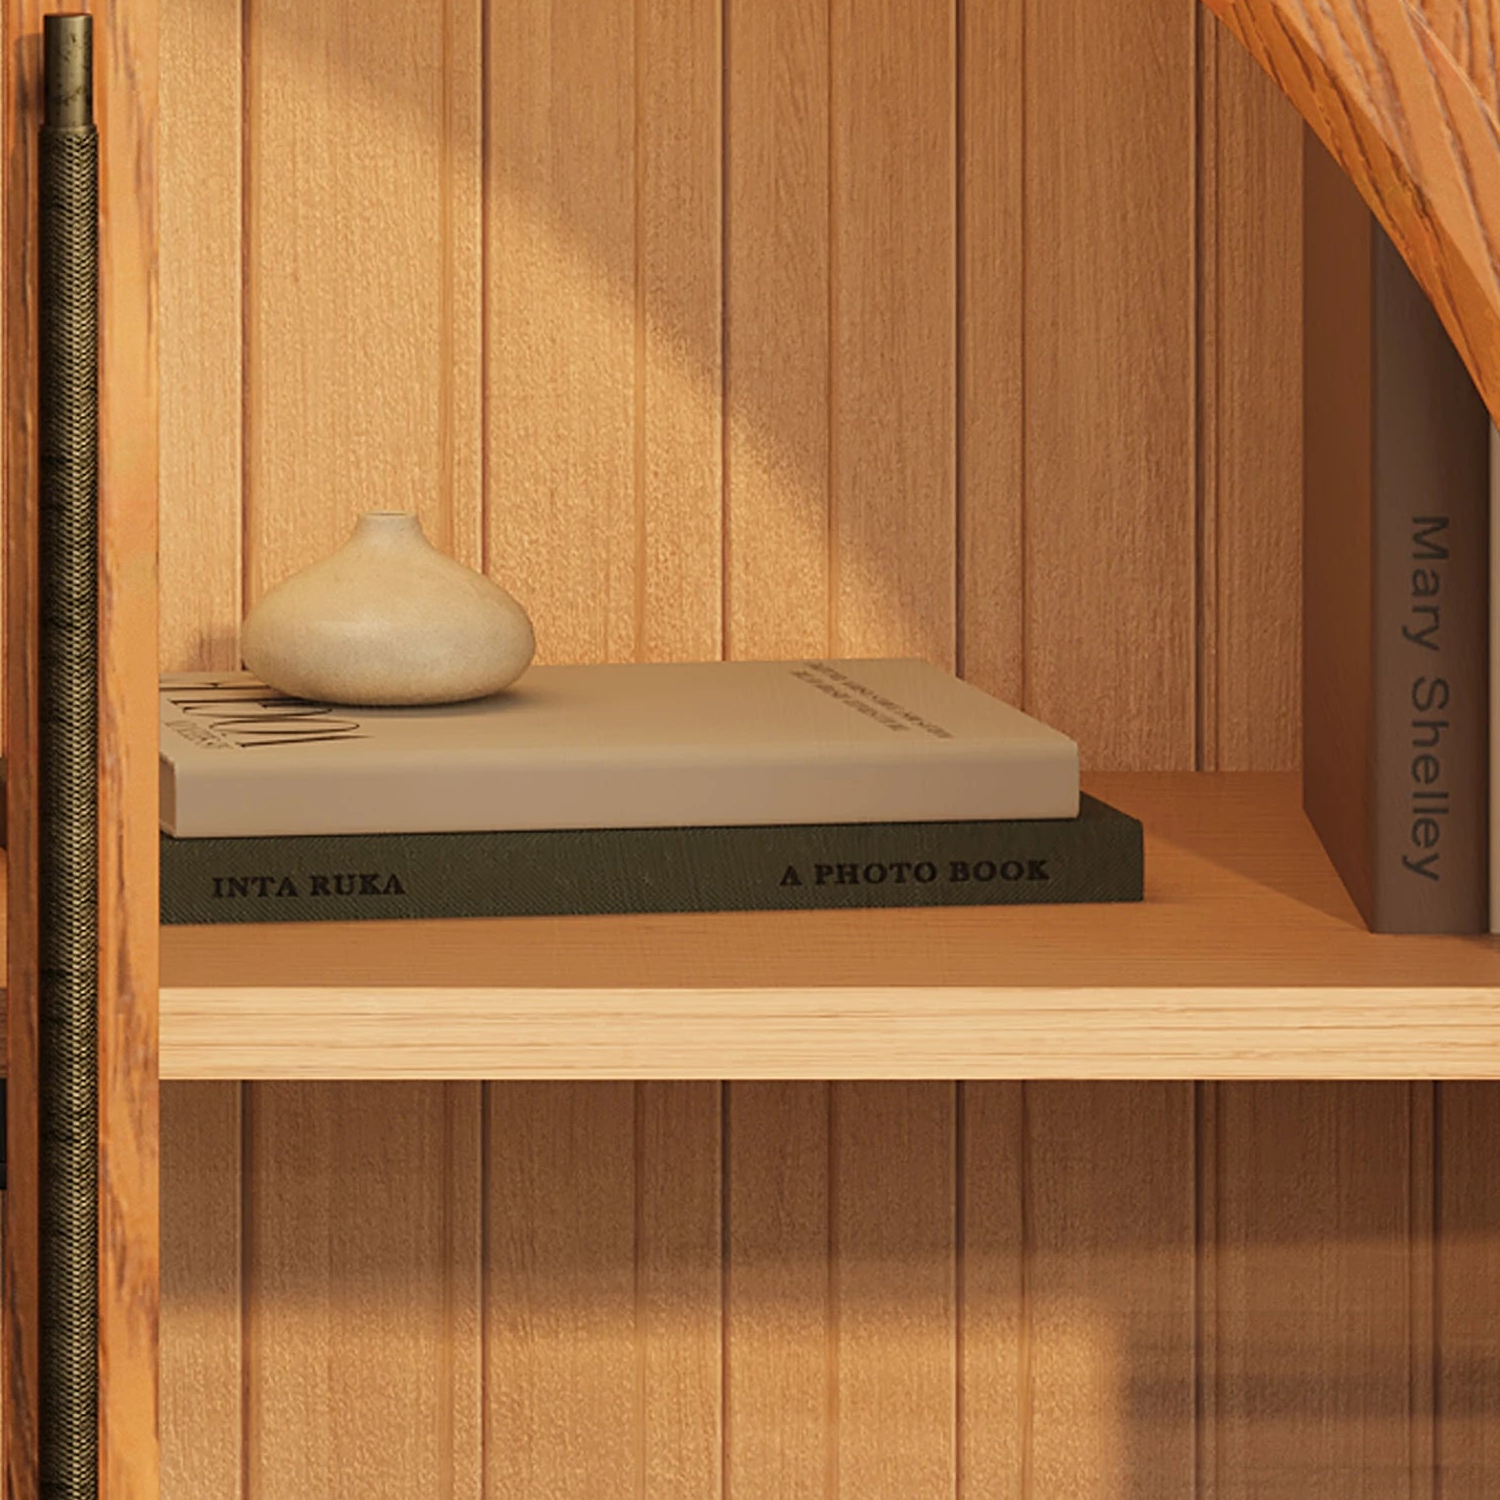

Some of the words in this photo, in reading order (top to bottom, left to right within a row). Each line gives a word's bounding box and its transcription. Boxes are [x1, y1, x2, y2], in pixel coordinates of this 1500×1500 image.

[1403, 516, 1451, 651] Mary
[1402, 677, 1450, 882] Shelley
[211, 875, 299, 899] INTA
[308, 872, 407, 897] RUKA
[779, 864, 803, 887] A
[814, 861, 938, 886] PHOTO
[949, 859, 1050, 883] BOOK
